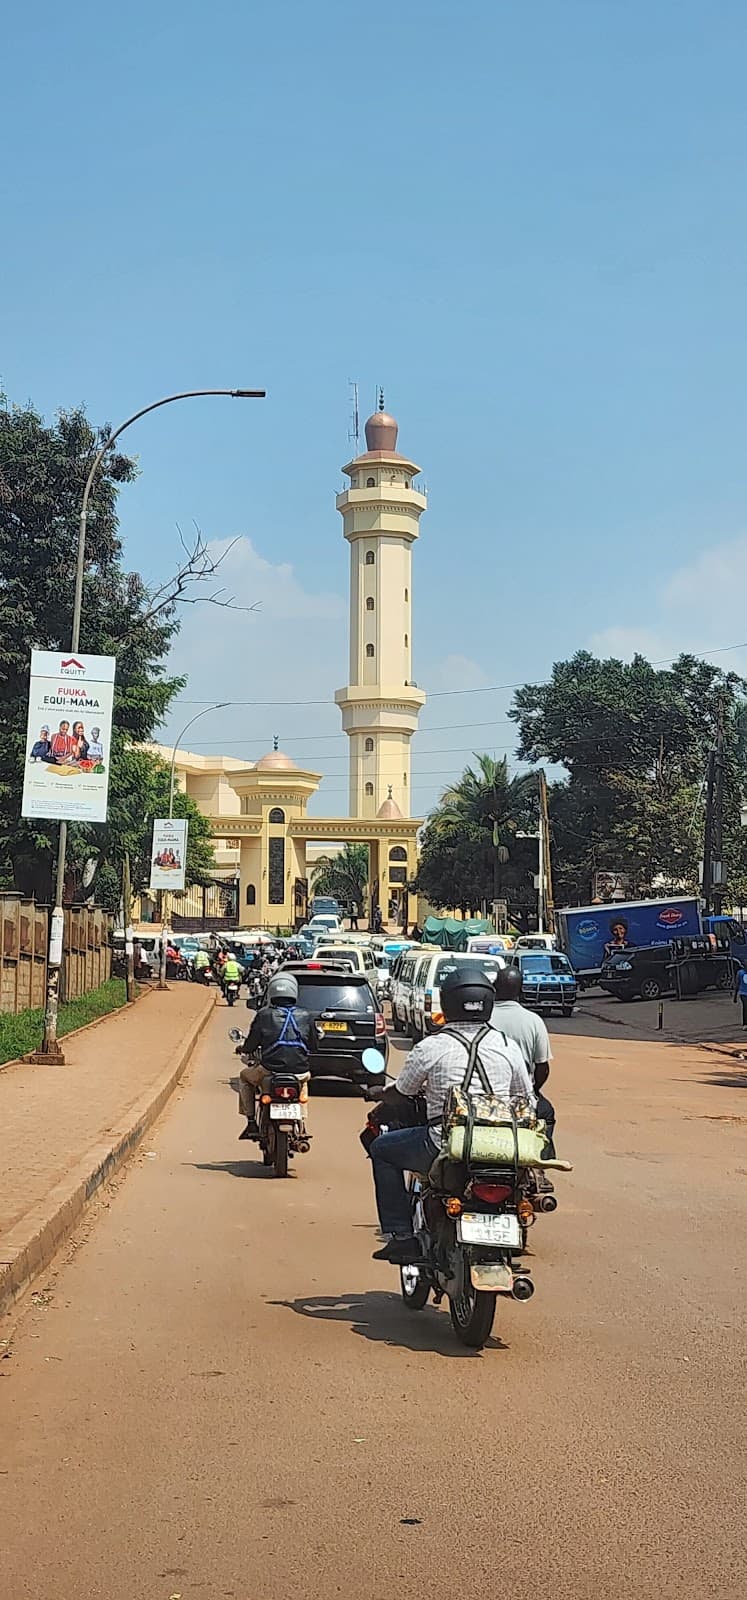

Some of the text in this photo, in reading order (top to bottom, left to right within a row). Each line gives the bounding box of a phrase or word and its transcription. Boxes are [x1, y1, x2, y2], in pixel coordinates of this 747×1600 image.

[60, 668, 87, 676] EQUITY
[57, 687, 87, 697] FUUKA
[43, 695, 100, 708] EQUI-MAMA
